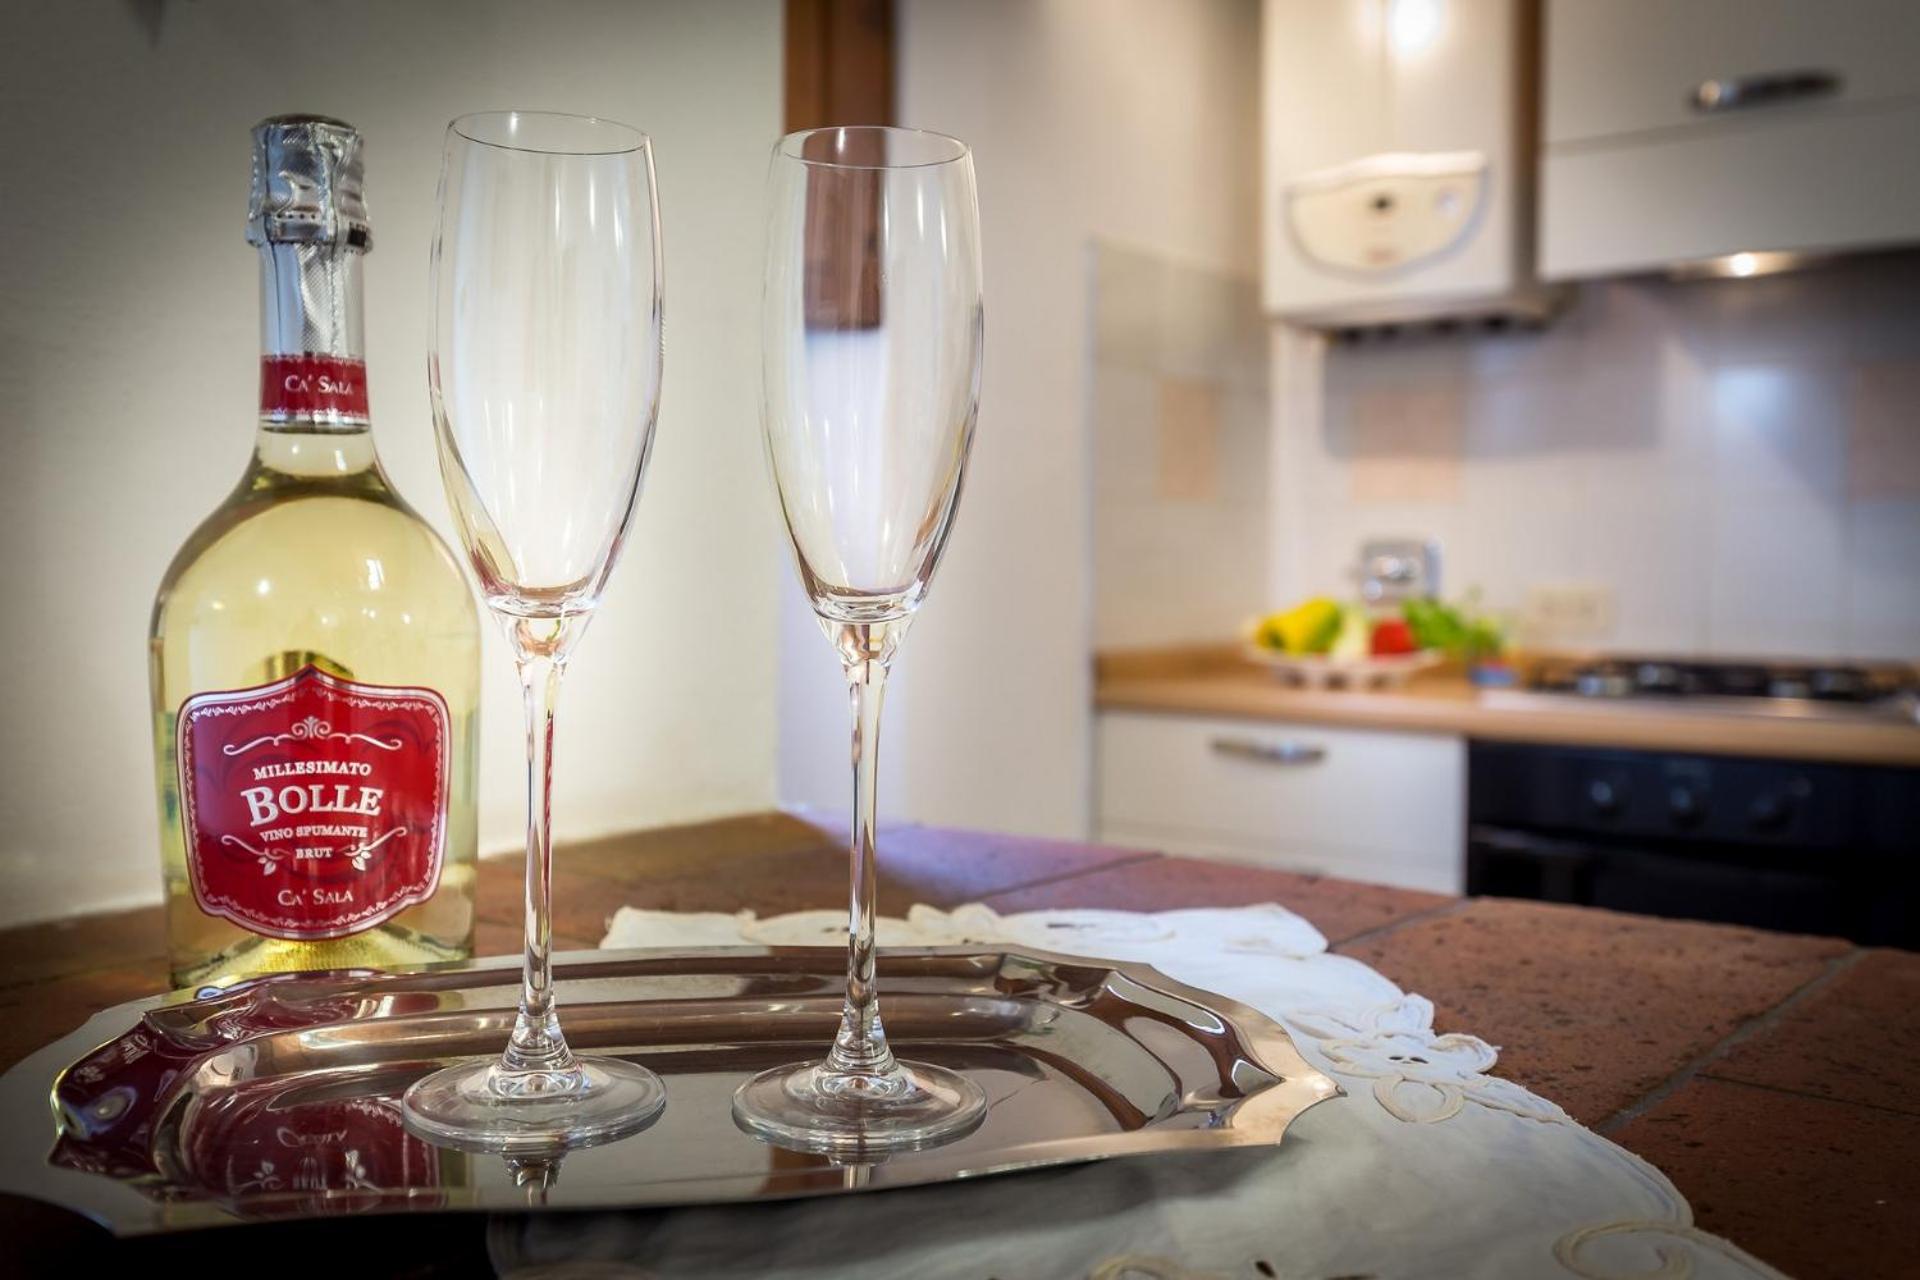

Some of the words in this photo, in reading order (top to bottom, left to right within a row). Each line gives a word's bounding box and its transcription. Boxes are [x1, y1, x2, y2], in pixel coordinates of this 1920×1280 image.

[253, 761, 372, 780] MILLESIMATO
[240, 785, 384, 827] BOLLE
[260, 827, 293, 842] VINO
[296, 825, 368, 839] SPUMANTE
[296, 848, 333, 859] BRUT
